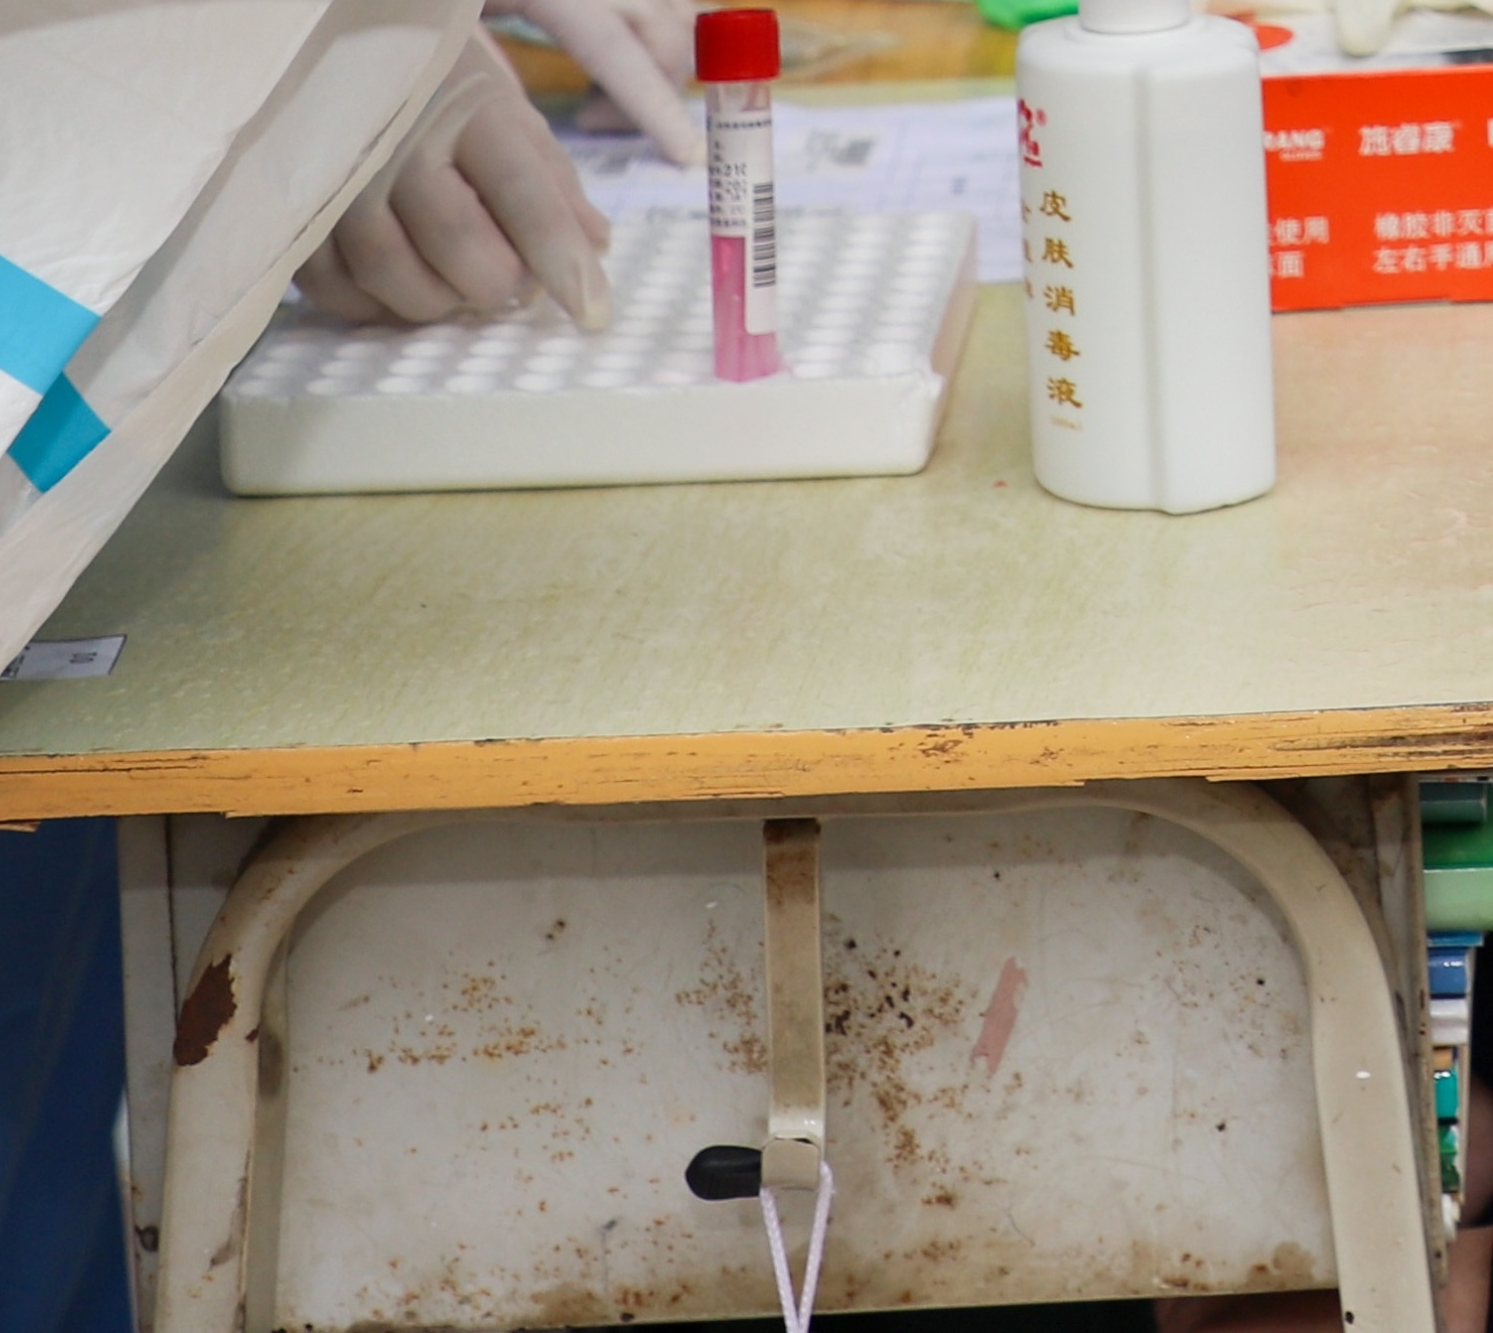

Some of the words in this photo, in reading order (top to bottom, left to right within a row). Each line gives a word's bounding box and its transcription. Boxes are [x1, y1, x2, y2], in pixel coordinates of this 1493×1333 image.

[1269, 215, 1330, 245] 使用
[1269, 249, 1305, 280] 面
[1039, 190, 1084, 410] 皮肤消毒液
